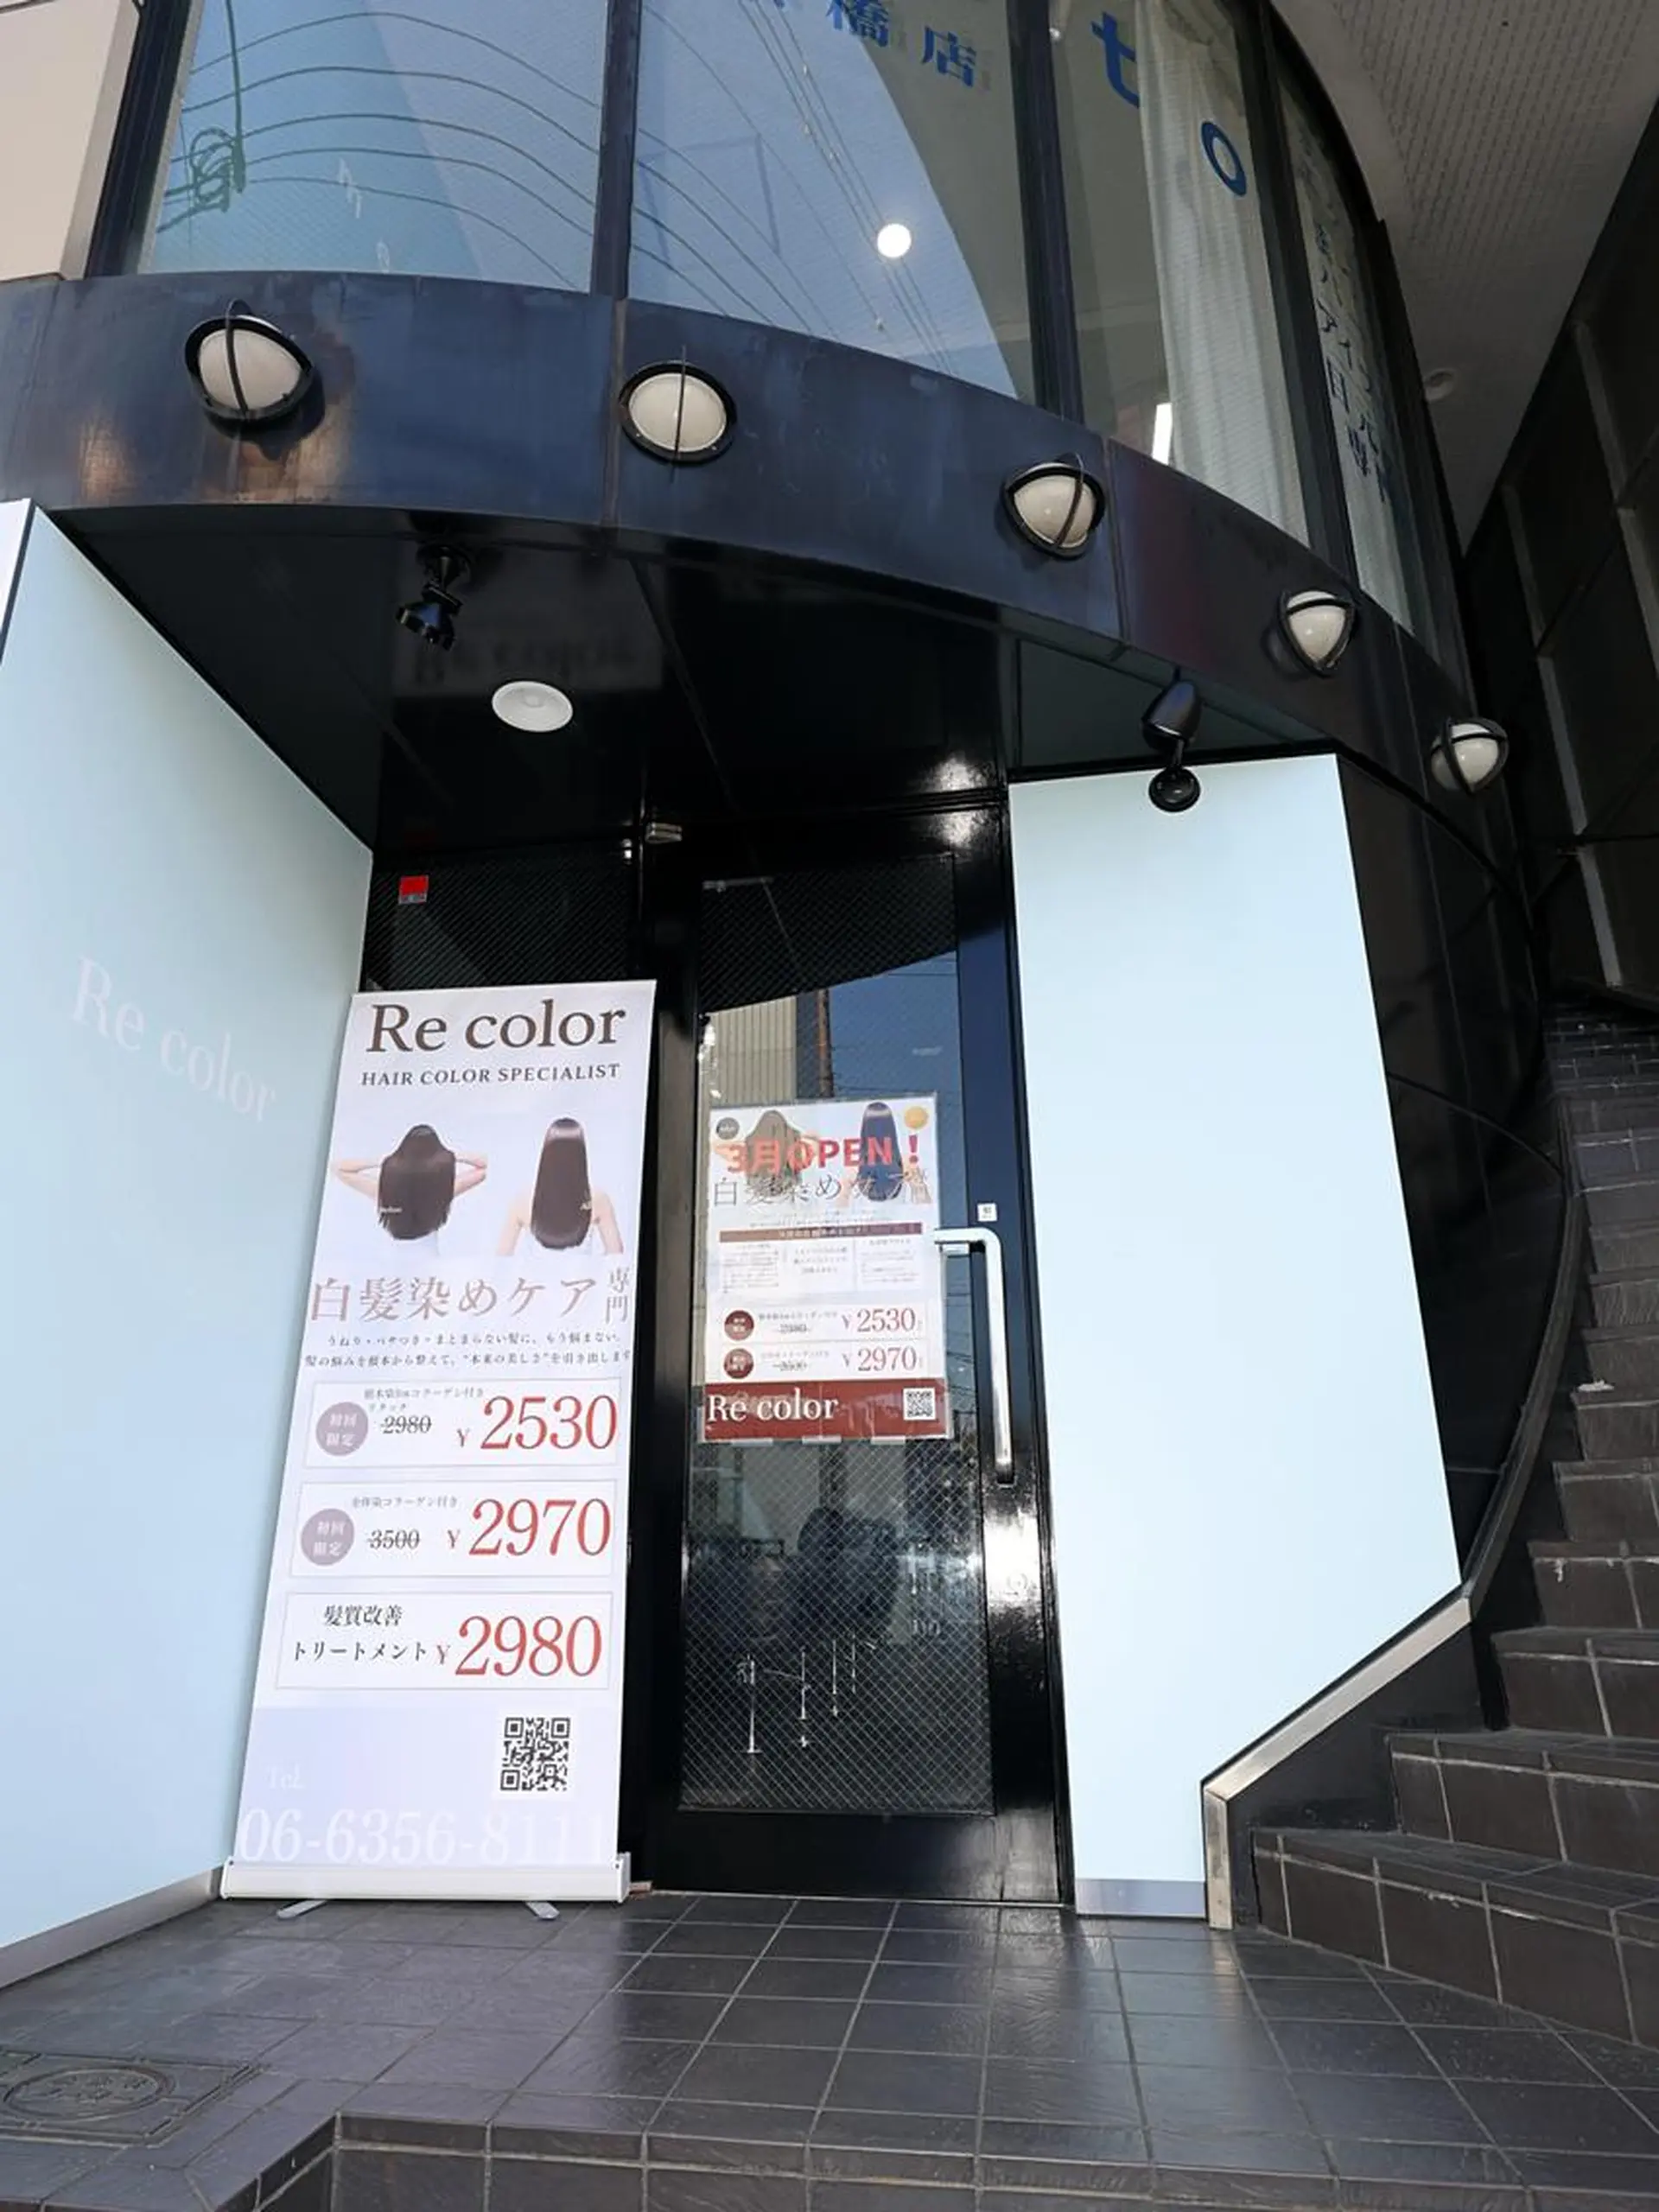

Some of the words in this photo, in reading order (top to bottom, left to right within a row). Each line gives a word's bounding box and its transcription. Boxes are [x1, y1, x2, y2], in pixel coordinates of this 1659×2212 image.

[366, 1002, 447, 1053] Re
[465, 999, 626, 1049] color
[72, 954, 145, 1051] Re
[160, 1029, 276, 1122] color
[362, 1070, 412, 1086] HAIR
[420, 1067, 491, 1085] COLOR
[498, 1063, 621, 1083] SPECIALIST
[708, 1394, 747, 1421] Re
[757, 1388, 838, 1420] color
[381, 1414, 433, 1434] 2980
[369, 1529, 420, 1549] 3500
[324, 1605, 404, 1627] 髪質改善
[294, 1641, 428, 1662] トリートメント
